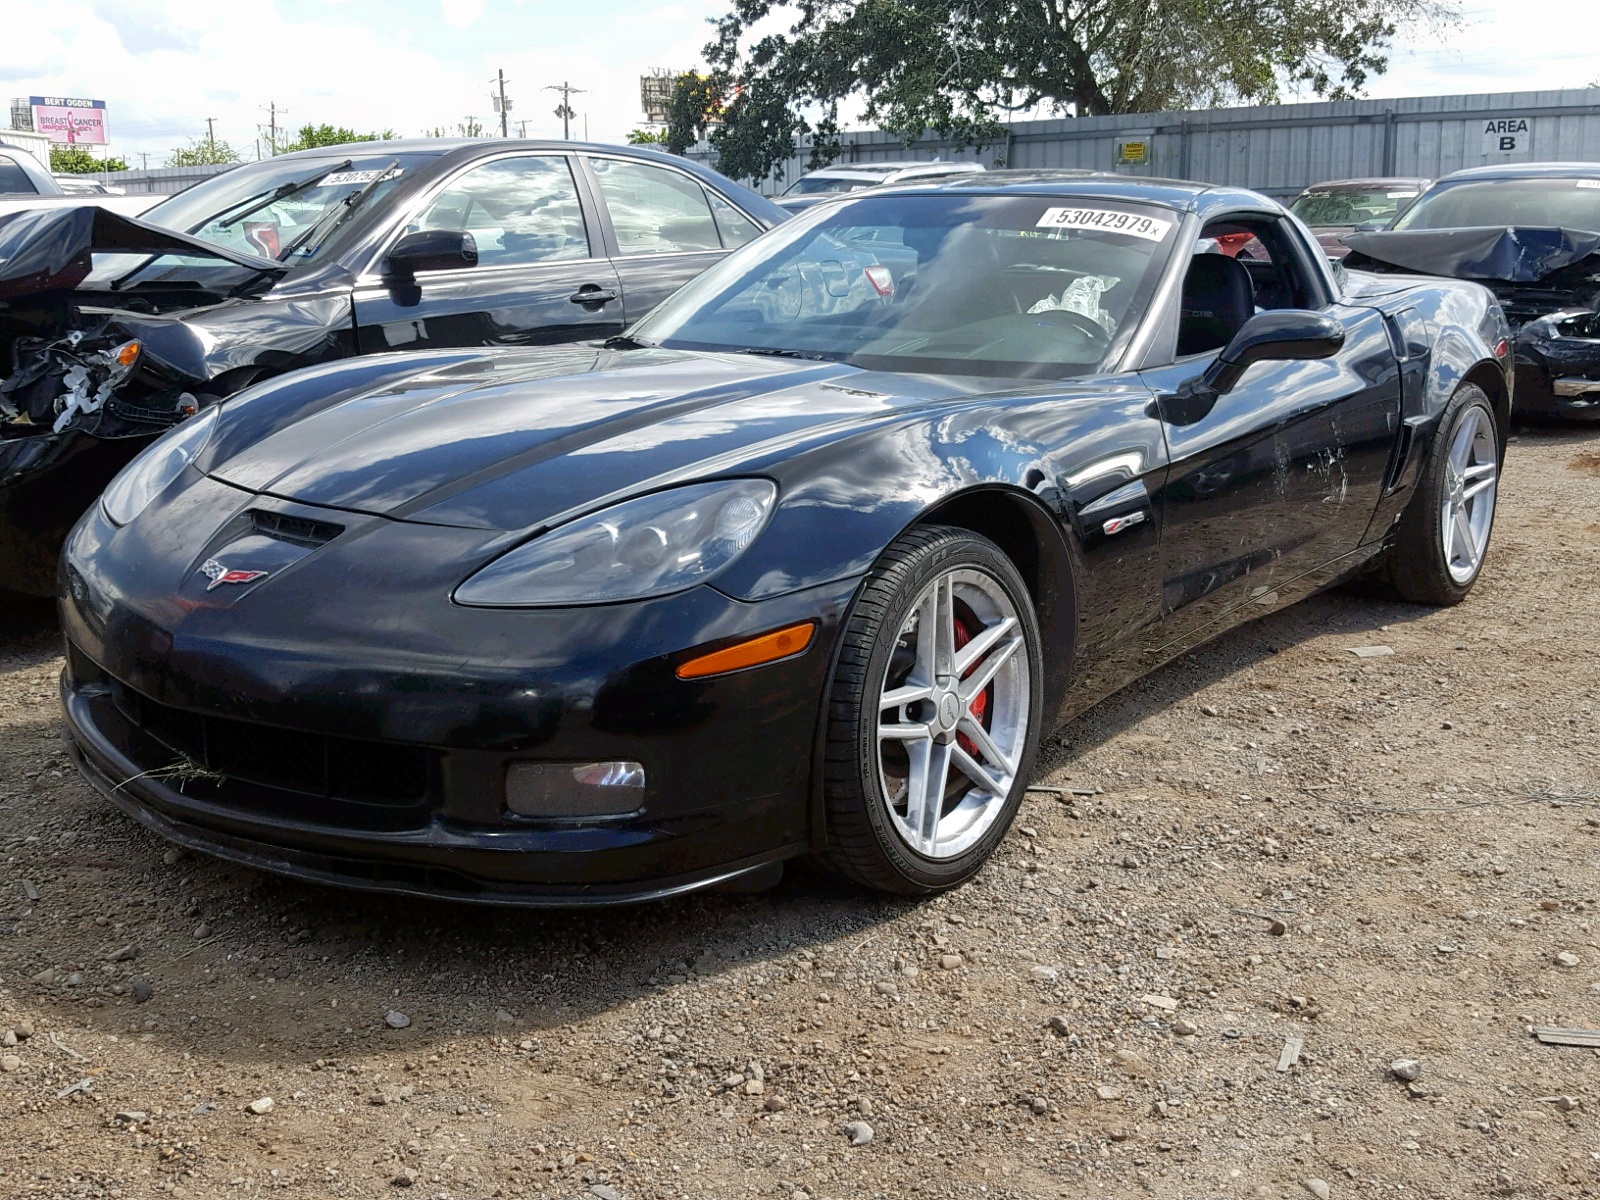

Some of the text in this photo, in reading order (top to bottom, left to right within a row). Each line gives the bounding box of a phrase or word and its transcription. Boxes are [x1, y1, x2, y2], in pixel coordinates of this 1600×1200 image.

[44, 97, 93, 108] BERT OGDEN
[40, 116, 68, 126] BREAST
[74, 118, 102, 128] CANCER
[1485, 120, 1528, 134] AREA
[1499, 137, 1516, 151] B
